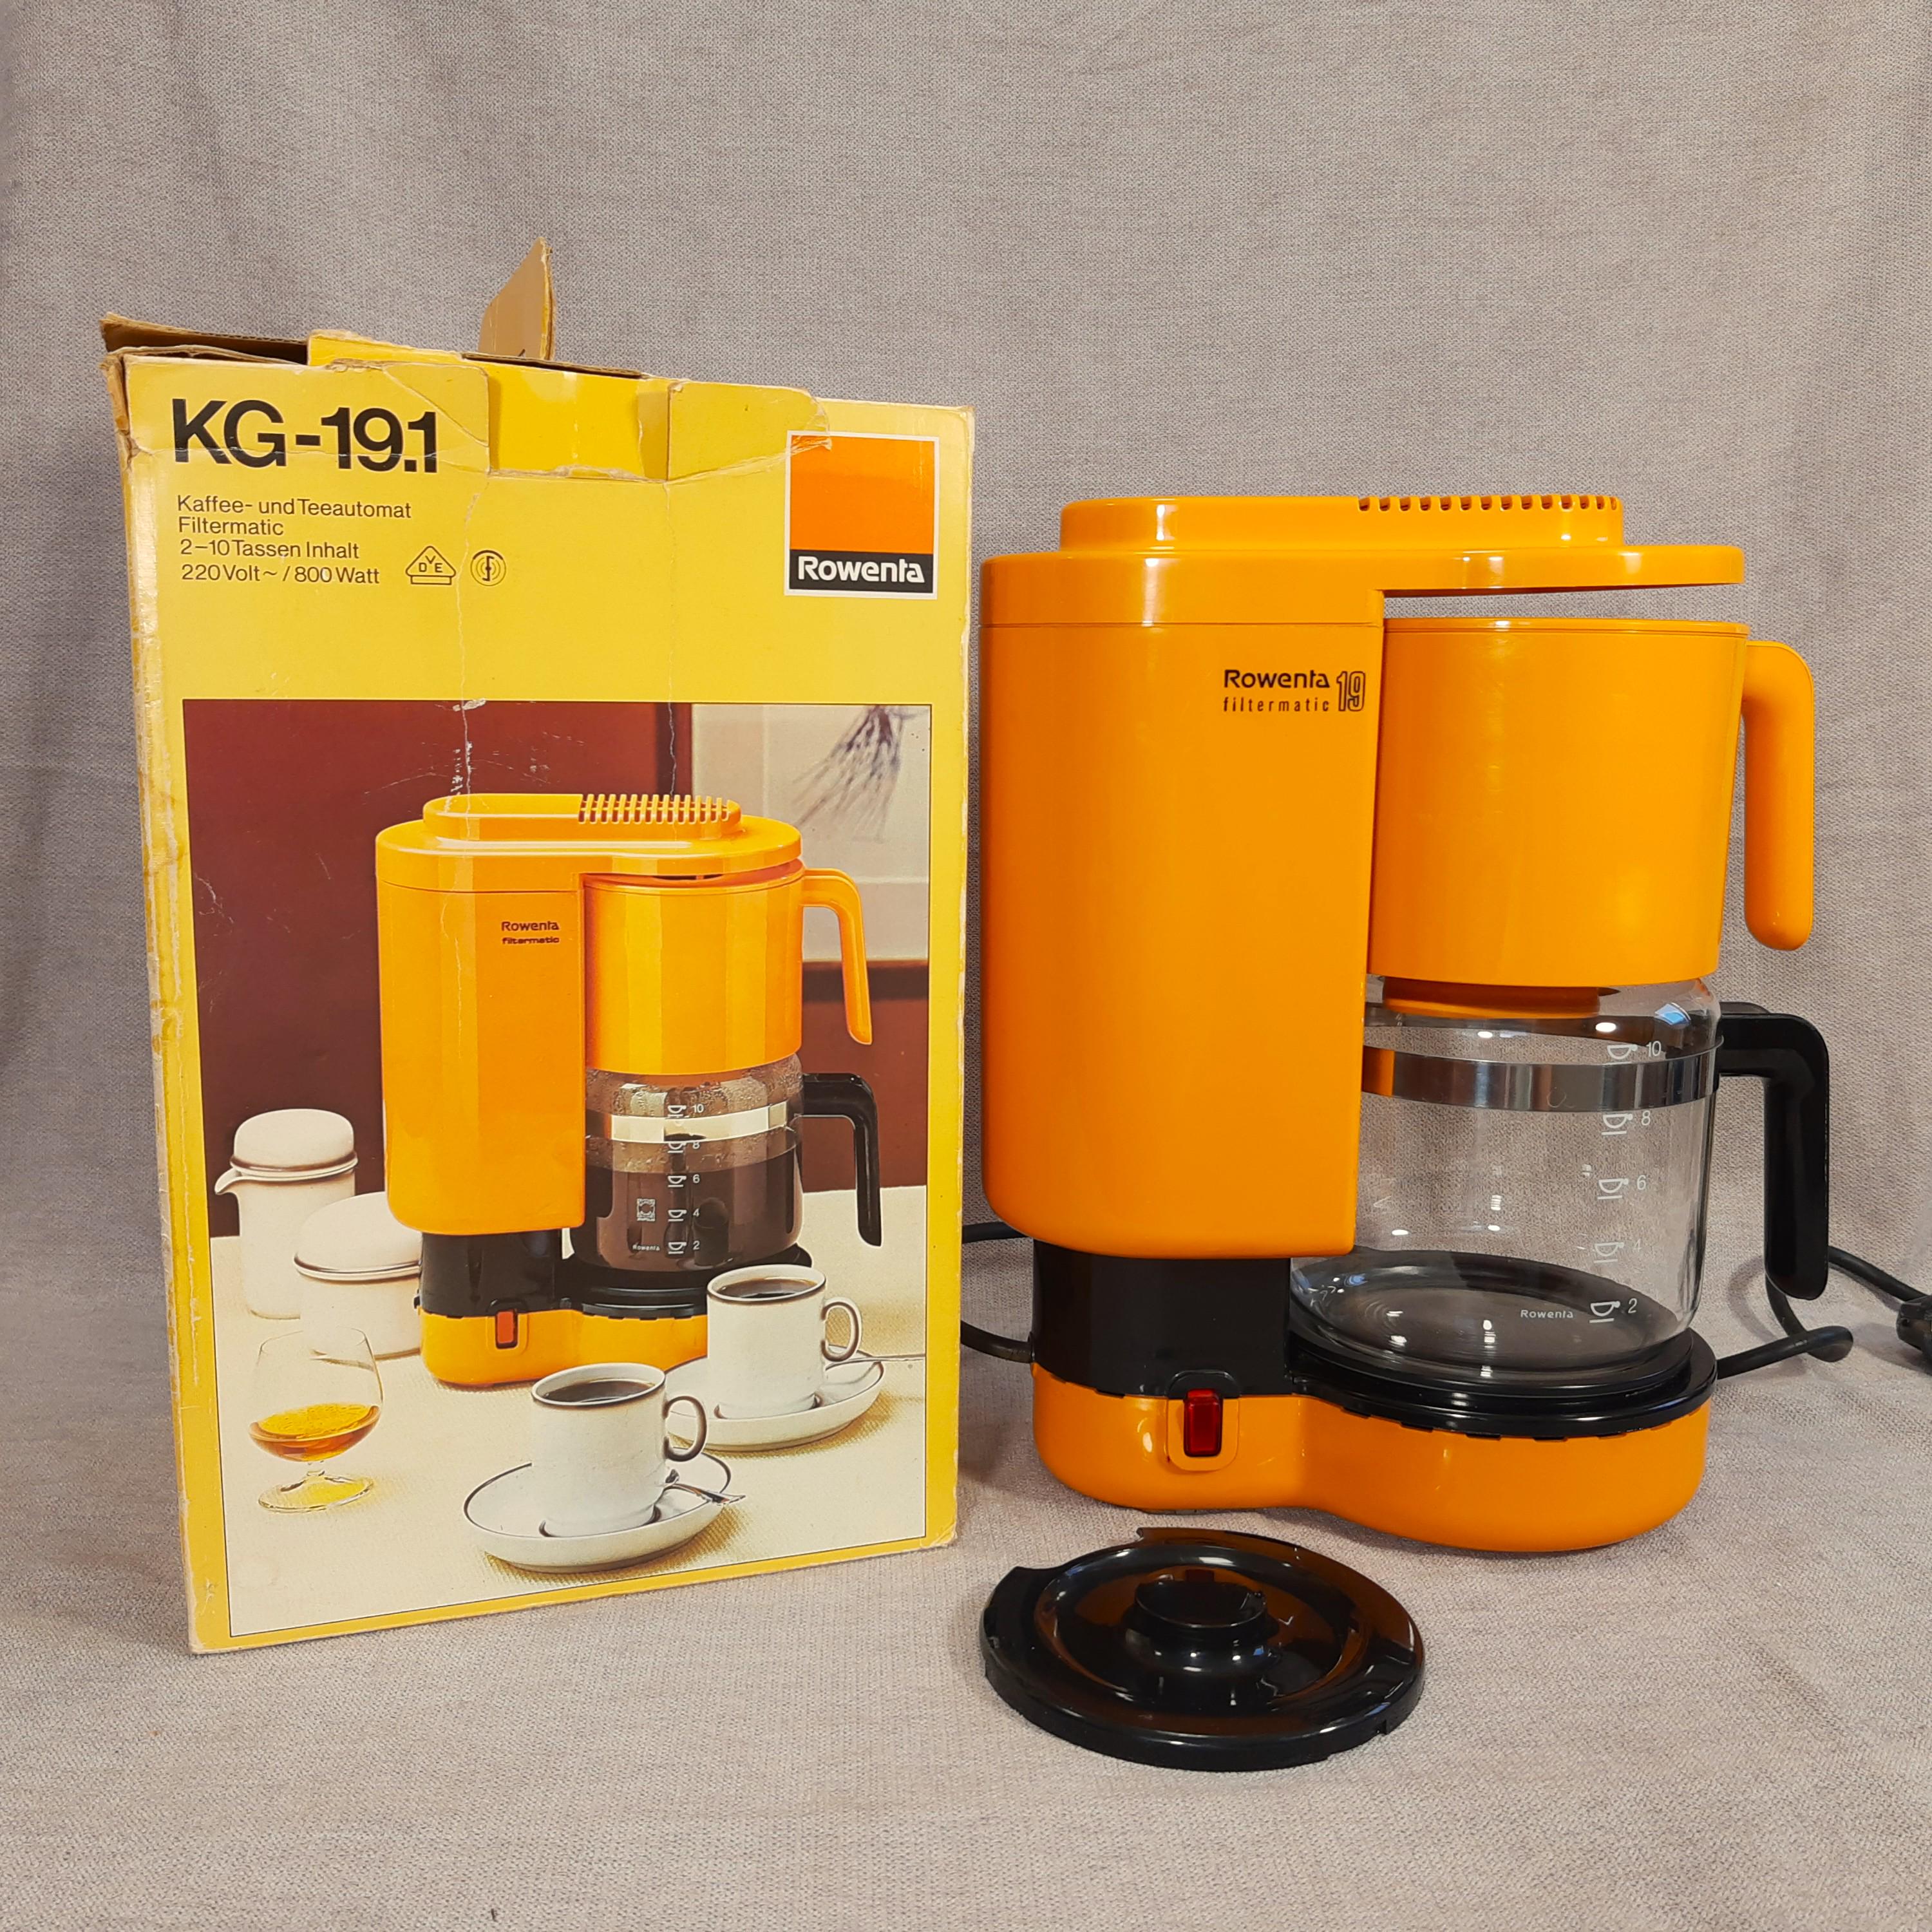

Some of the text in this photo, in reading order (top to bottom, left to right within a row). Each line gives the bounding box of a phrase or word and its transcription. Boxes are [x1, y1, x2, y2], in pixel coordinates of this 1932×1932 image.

[178, 495, 411, 518] Kaffee- und Teeautomat
[178, 517, 284, 536] Filtermatic
[232, 540, 300, 557] Tassen
[307, 542, 359, 559] Inhalt
[182, 564, 220, 582] 220
[223, 565, 261, 582] Volt
[294, 567, 332, 583] 800
[335, 567, 380, 584] Watt
[798, 556, 925, 583] Rowenta
[1224, 669, 1366, 712] Rowenta 19
[1224, 697, 1329, 712] filtermatic
[501, 921, 560, 931] Rowenta
[1645, 1040, 1662, 1057] 10
[692, 1104, 704, 1113] 10
[1640, 1110, 1651, 1126] 8
[692, 1141, 700, 1150] 8
[692, 1174, 700, 1184] 6
[1636, 1175, 1647, 1191] 6
[692, 1208, 700, 1217] 4
[692, 1241, 701, 1250] 2
[1520, 1309, 1574, 1319] Rowenta
[1627, 1298, 1638, 1314] 2
